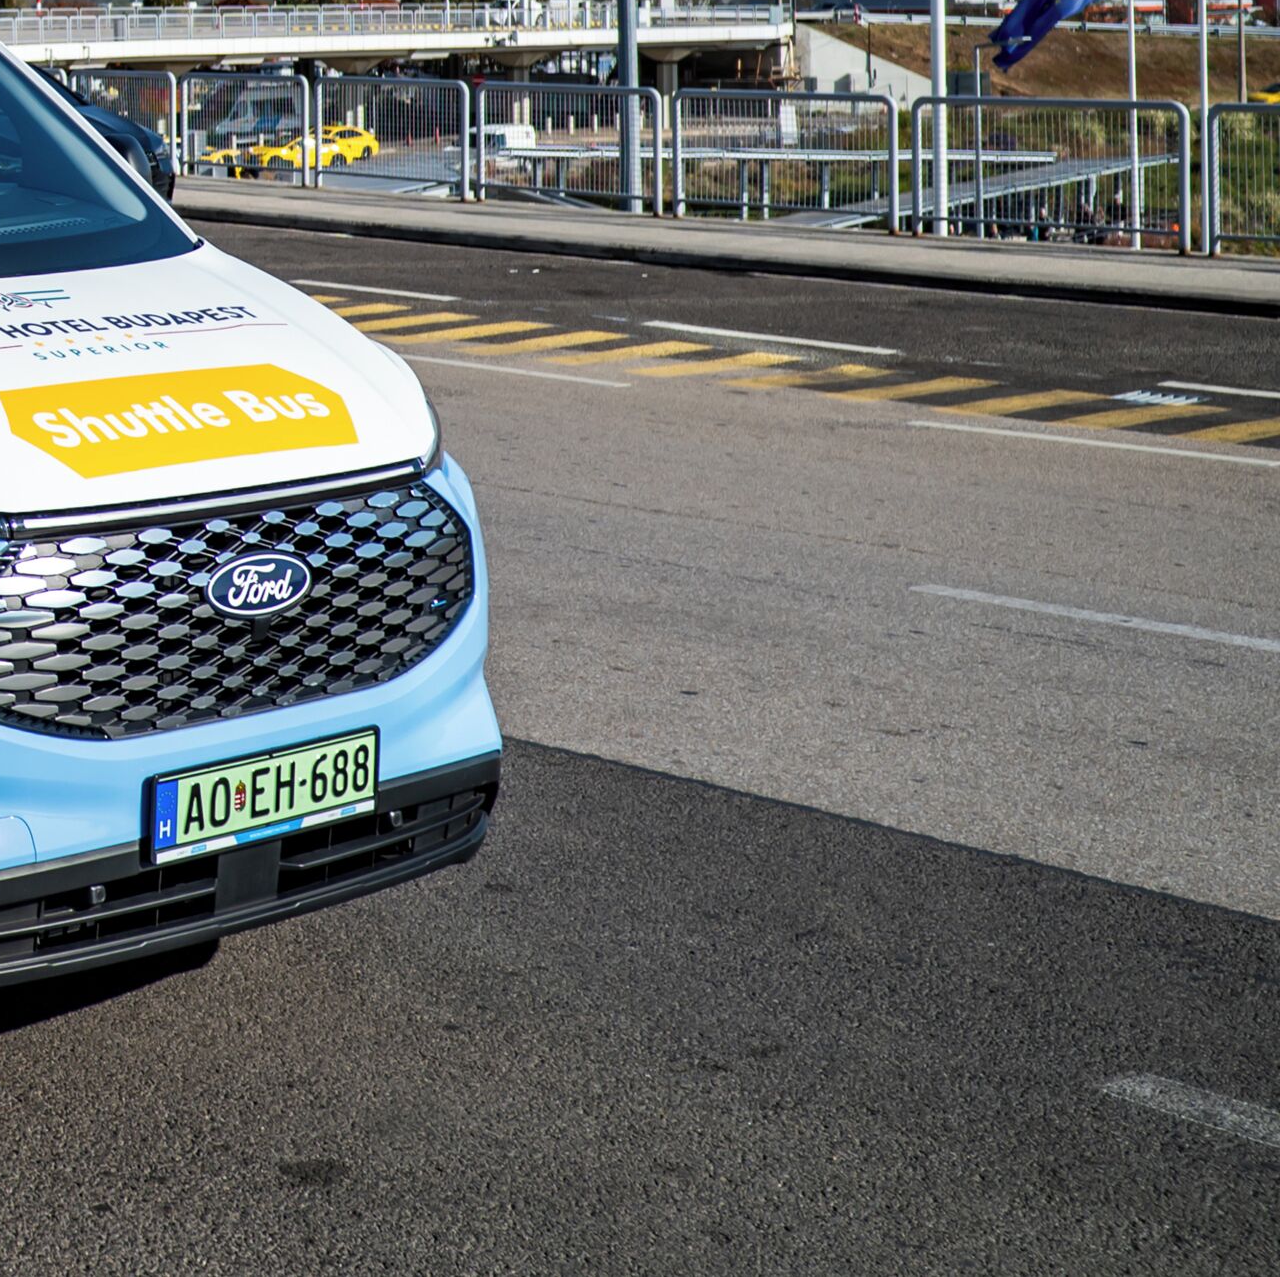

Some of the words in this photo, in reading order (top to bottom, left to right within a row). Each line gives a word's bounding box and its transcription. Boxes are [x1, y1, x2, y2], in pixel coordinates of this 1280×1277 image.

[101, 305, 259, 332] BUDAPEST
[33, 339, 169, 362] SUPERIOR
[31, 394, 231, 448] Shuttle
[221, 389, 330, 423] Bus
[227, 562, 293, 607] Ford
[250, 743, 370, 820] EH-688
[159, 819, 171, 839] H
